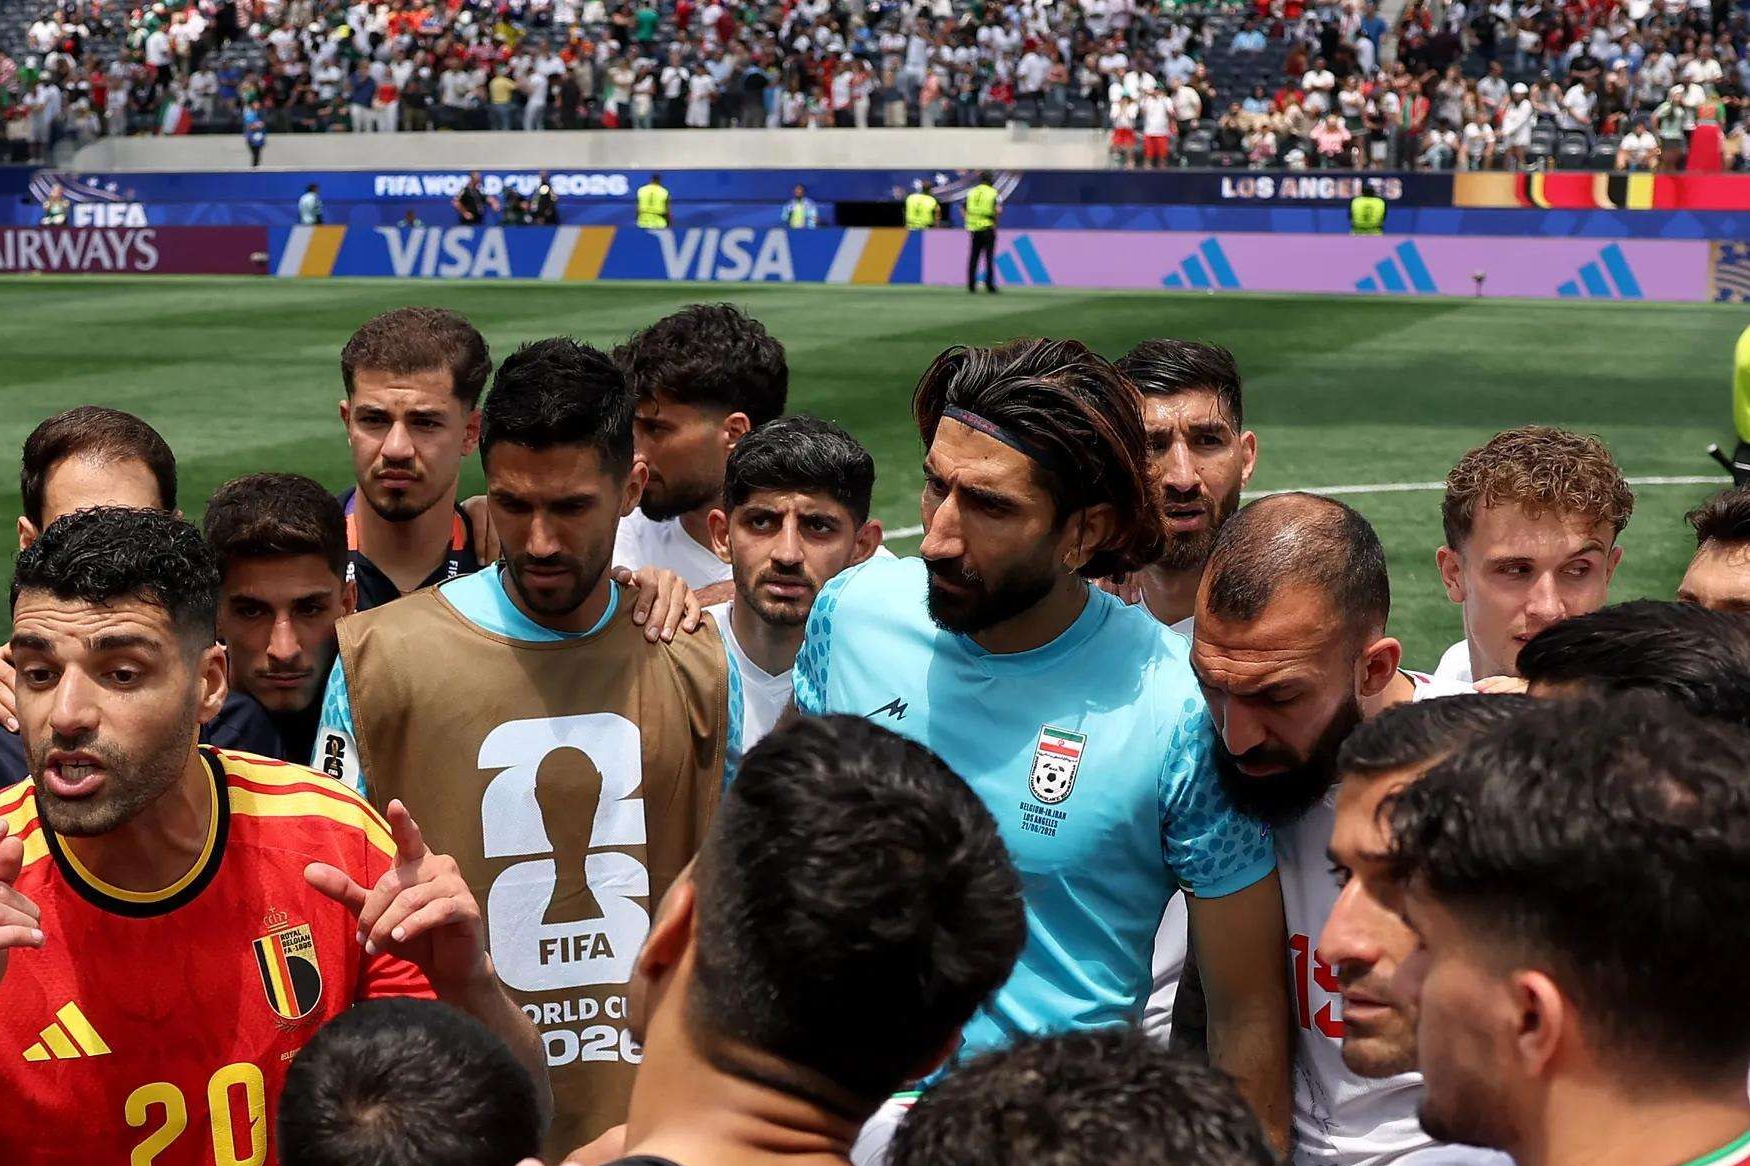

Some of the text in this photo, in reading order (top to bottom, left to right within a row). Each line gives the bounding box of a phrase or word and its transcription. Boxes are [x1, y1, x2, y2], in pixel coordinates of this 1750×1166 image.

[374, 175, 422, 196] FIFA
[423, 175, 501, 196] WOD
[550, 174, 629, 196] 2026
[1221, 176, 1275, 199] LOS
[73, 202, 148, 228] FIFA
[376, 226, 511, 277] VISA
[647, 228, 795, 281] VISA
[280, 930, 302, 940] ROYAL
[281, 934, 311, 947] BELGIAN
[539, 932, 615, 965] FIFA
[521, 998, 600, 1025] ORLD
[541, 1024, 645, 1067] 026
